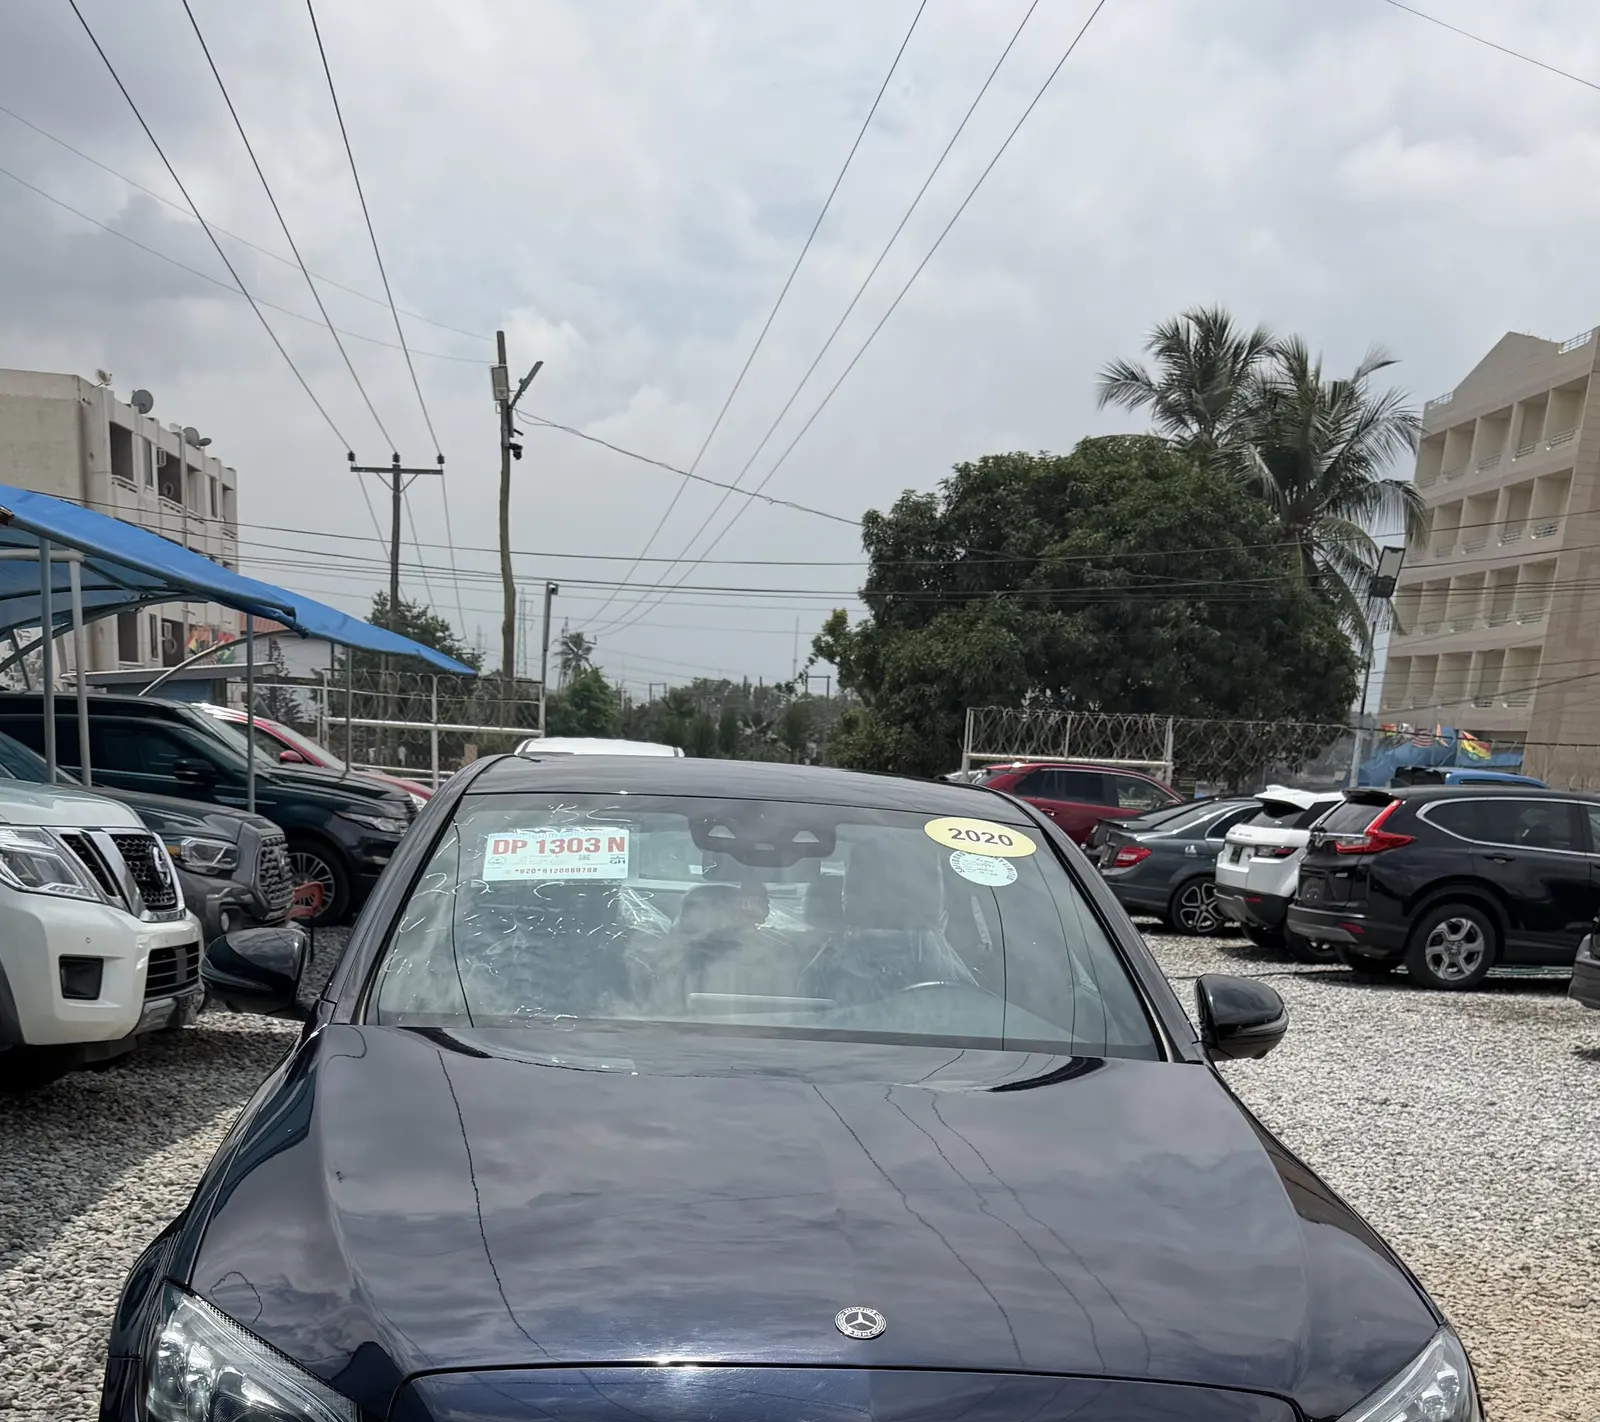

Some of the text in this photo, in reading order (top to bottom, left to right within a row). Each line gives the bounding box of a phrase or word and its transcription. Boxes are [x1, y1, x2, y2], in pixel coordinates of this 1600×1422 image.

[492, 836, 626, 855] DP 1303 N
[947, 827, 1014, 847] 2020
